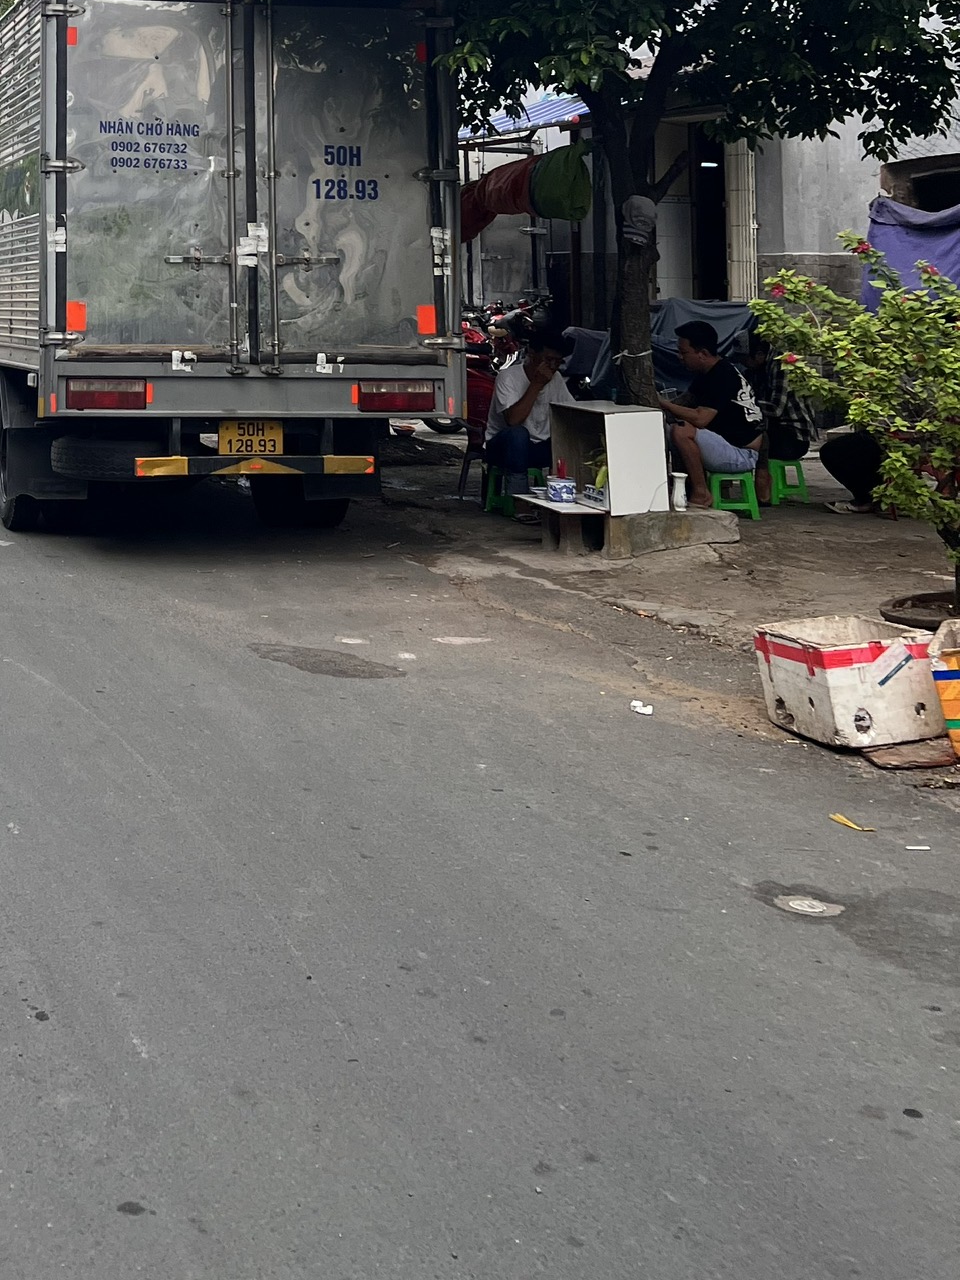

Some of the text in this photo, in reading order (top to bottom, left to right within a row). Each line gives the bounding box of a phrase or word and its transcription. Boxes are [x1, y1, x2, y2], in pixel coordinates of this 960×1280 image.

[99, 118, 200, 137] NHẬN CHỞ HÀNG
[111, 141, 188, 154] 0902 676732
[110, 157, 188, 170] 0902 676733
[324, 145, 362, 167] 50H
[312, 179, 379, 200] 128.93
[237, 422, 265, 437] 50H
[227, 438, 277, 453] 128.93
